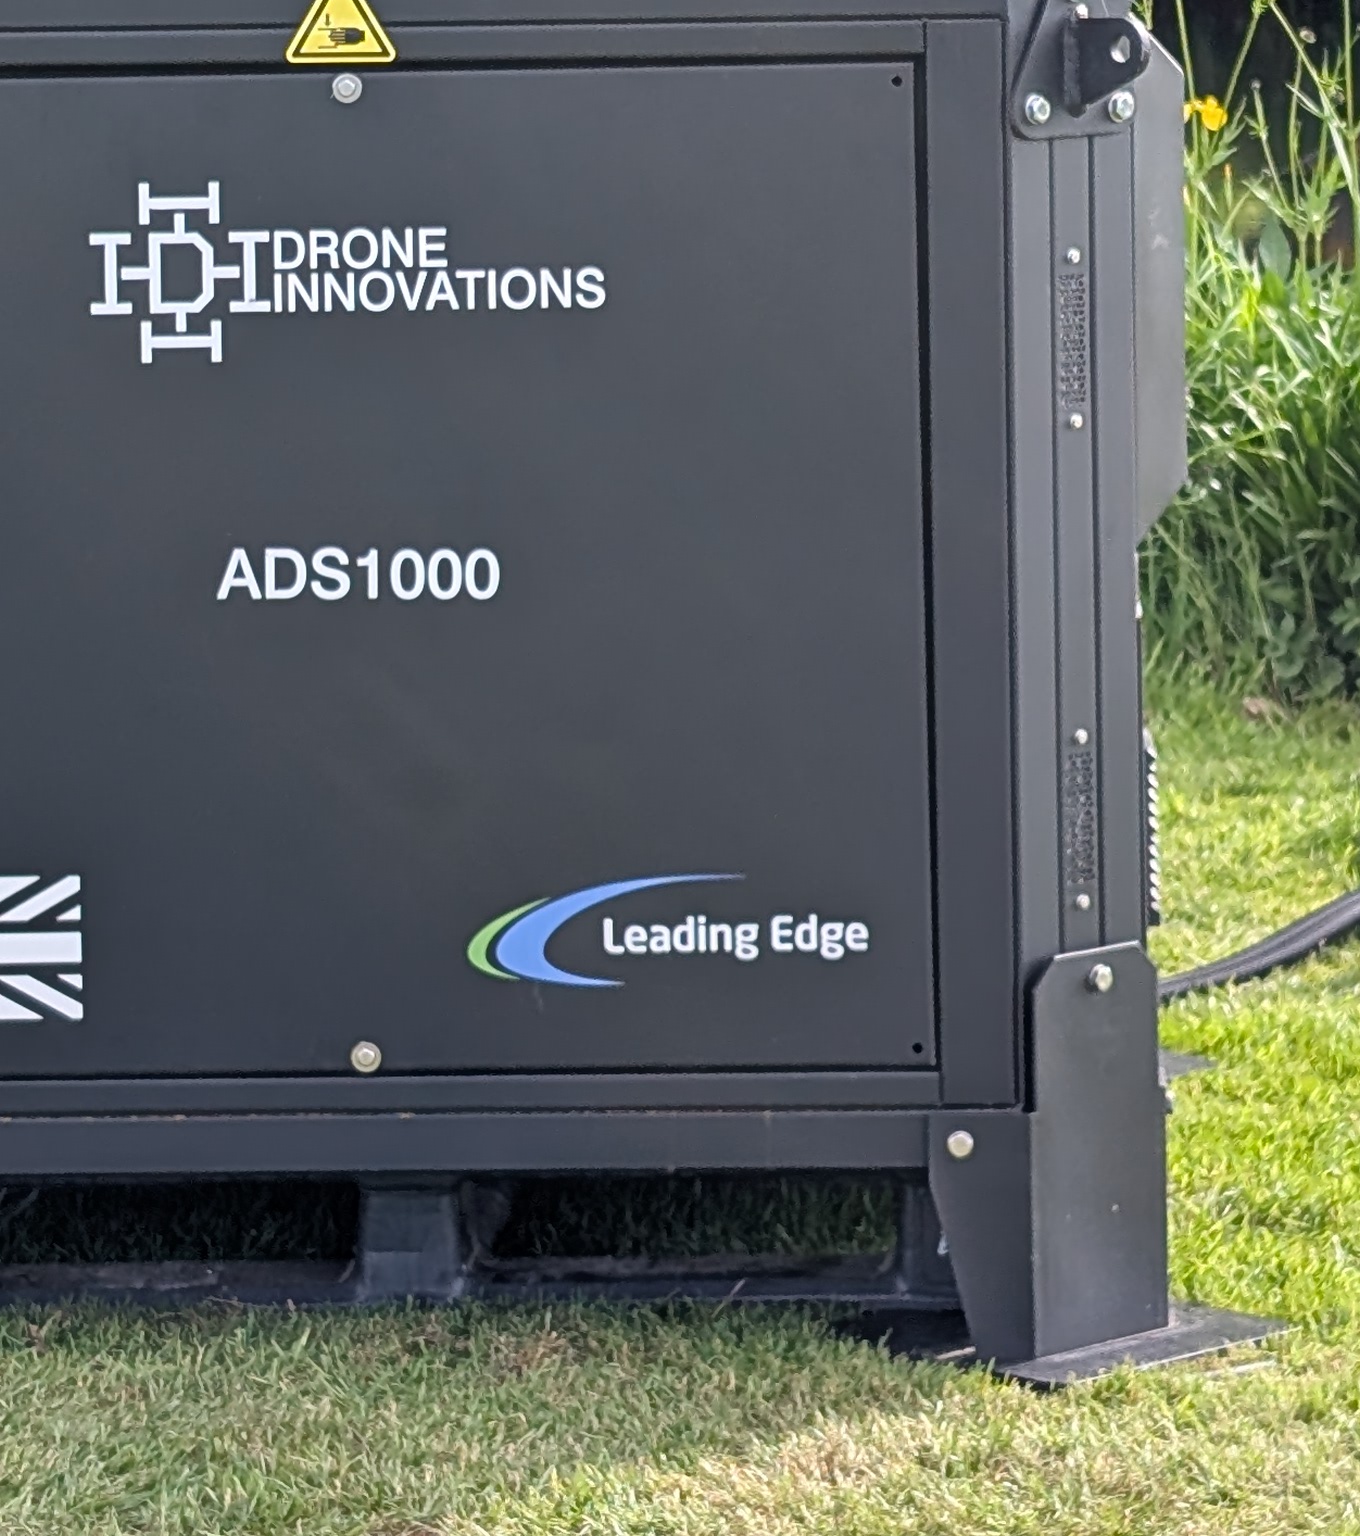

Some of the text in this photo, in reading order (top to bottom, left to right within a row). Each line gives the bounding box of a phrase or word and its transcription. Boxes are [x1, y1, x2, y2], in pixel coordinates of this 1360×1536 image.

[273, 227, 449, 269] DRONE
[273, 266, 607, 313] INNOVATIONS
[216, 546, 501, 601] ADS1000
[602, 913, 870, 961] Leading Edge
